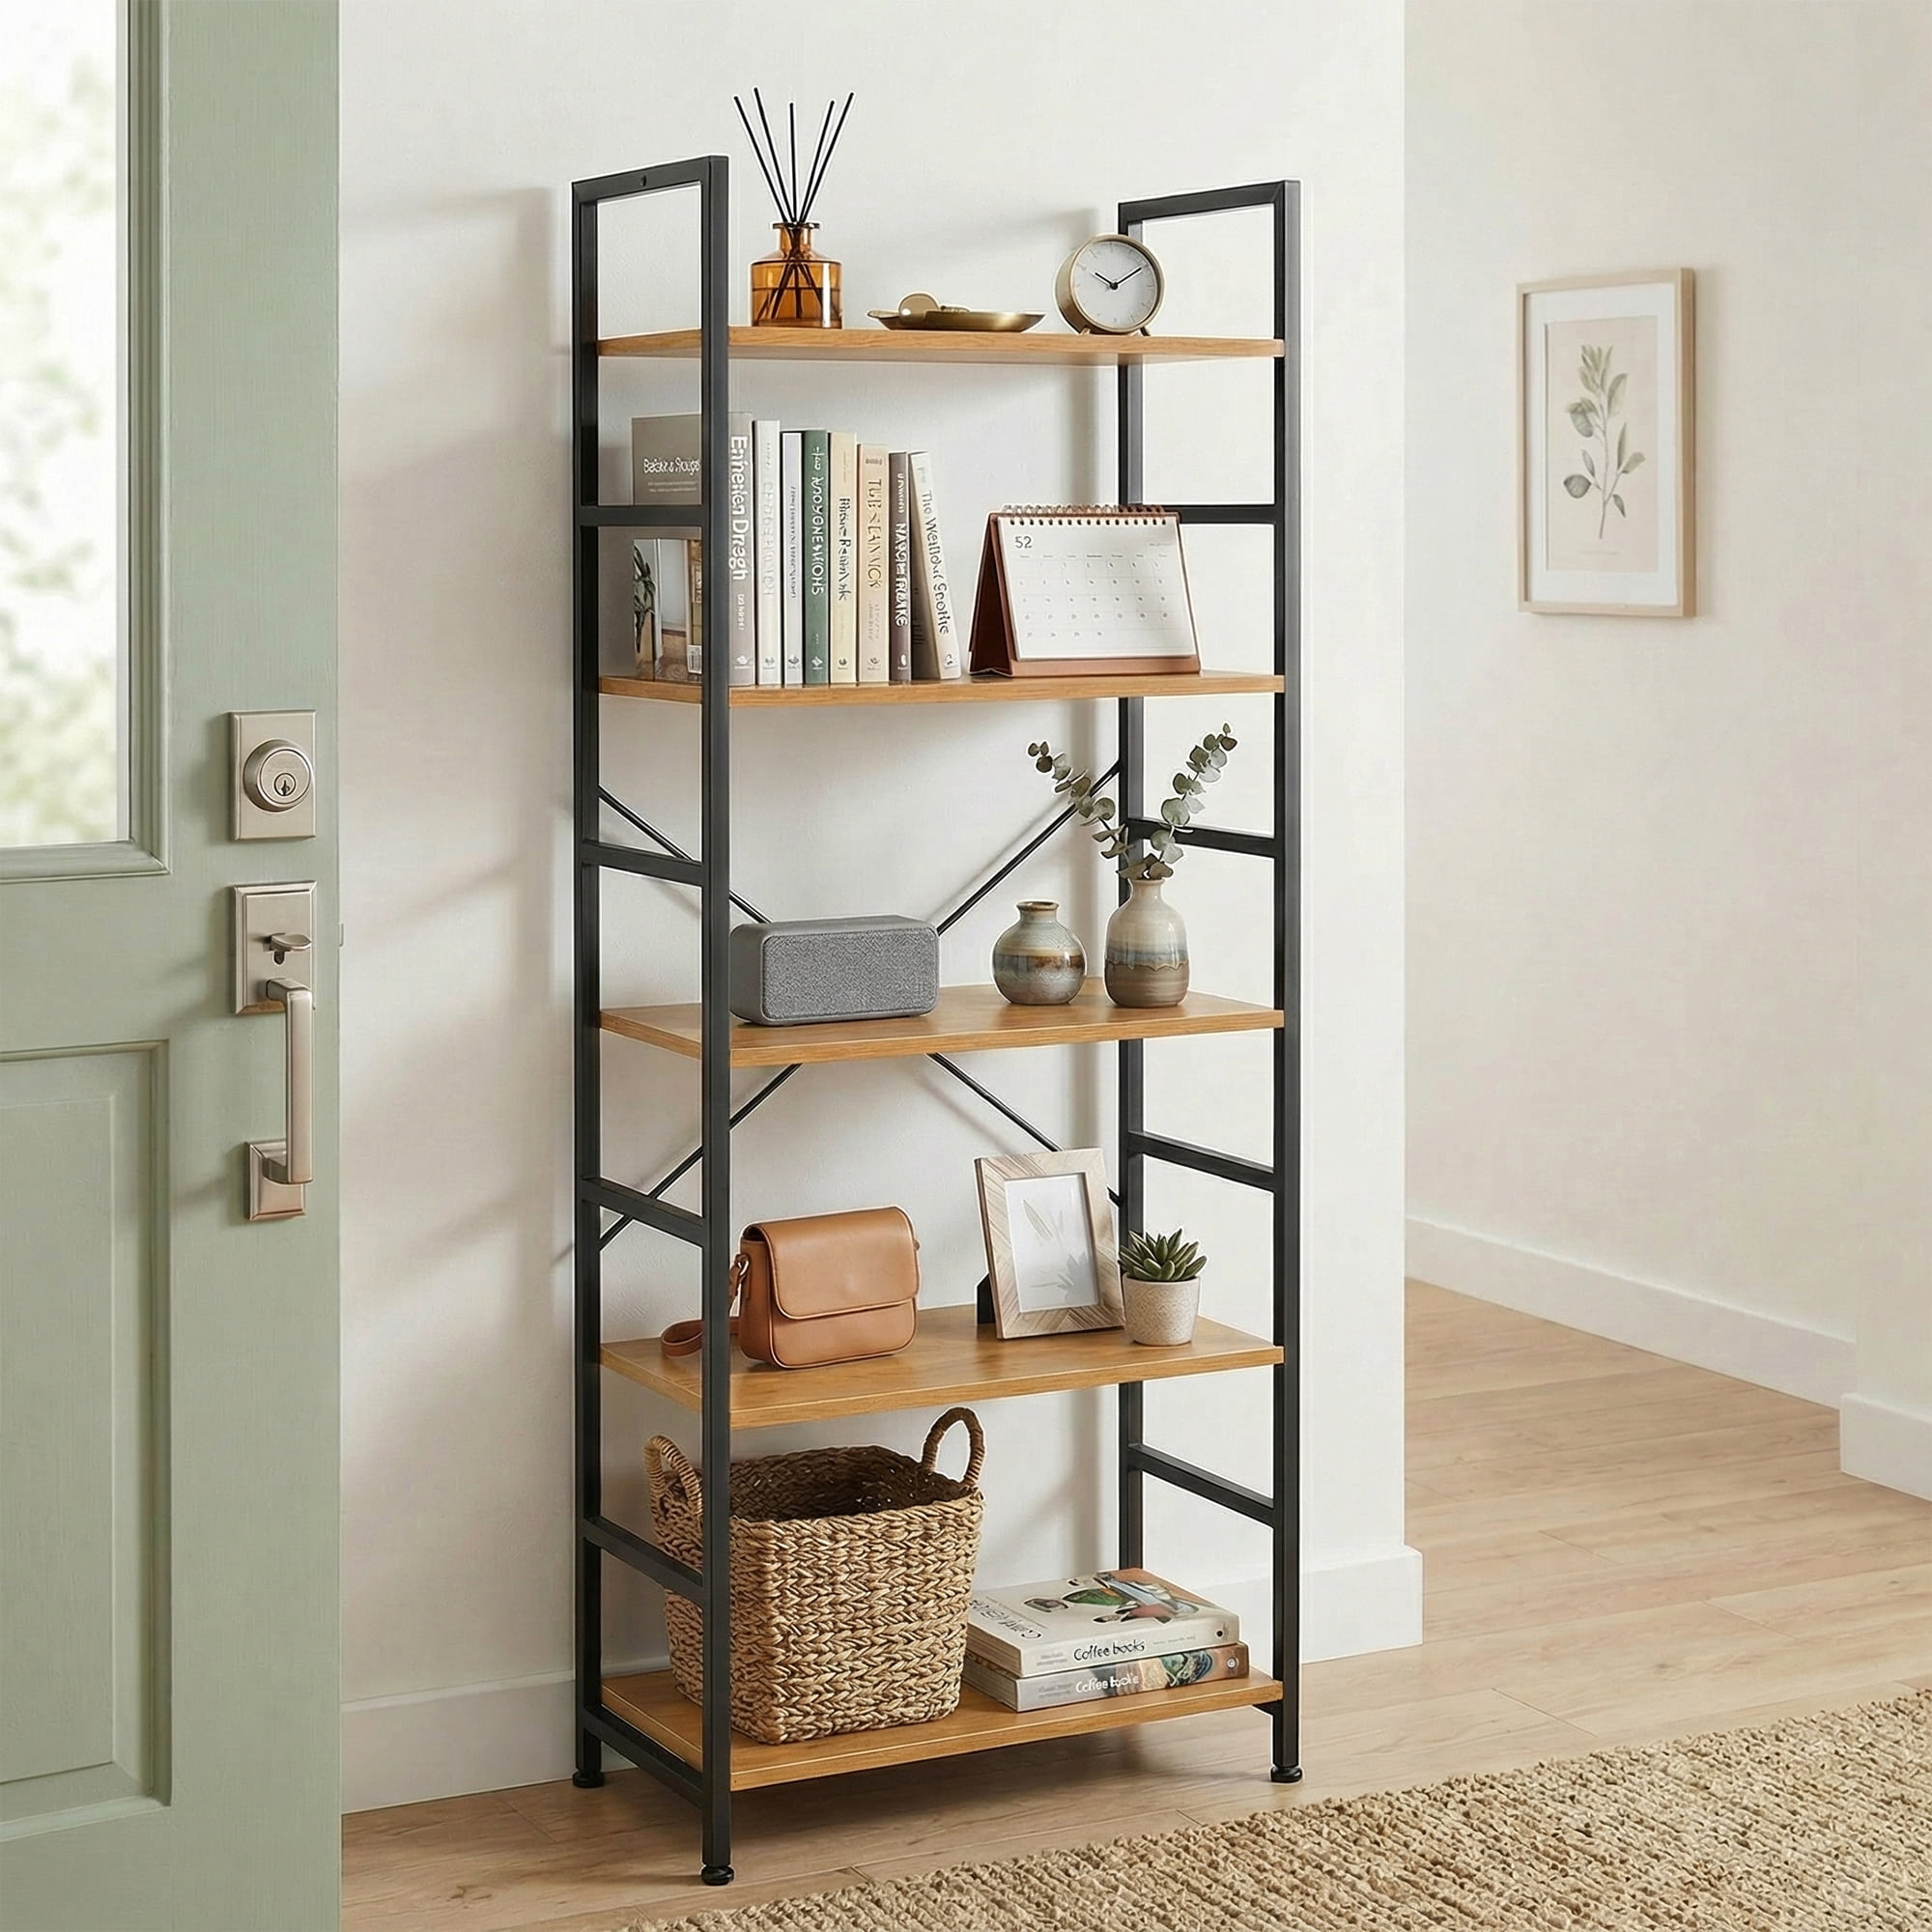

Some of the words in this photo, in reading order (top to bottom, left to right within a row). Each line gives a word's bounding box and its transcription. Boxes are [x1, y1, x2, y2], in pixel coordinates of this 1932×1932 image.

[1014, 535, 1034, 549] 52
[1073, 1645, 1111, 1662] Coffee
[1075, 1677, 1109, 1693] Coffee
